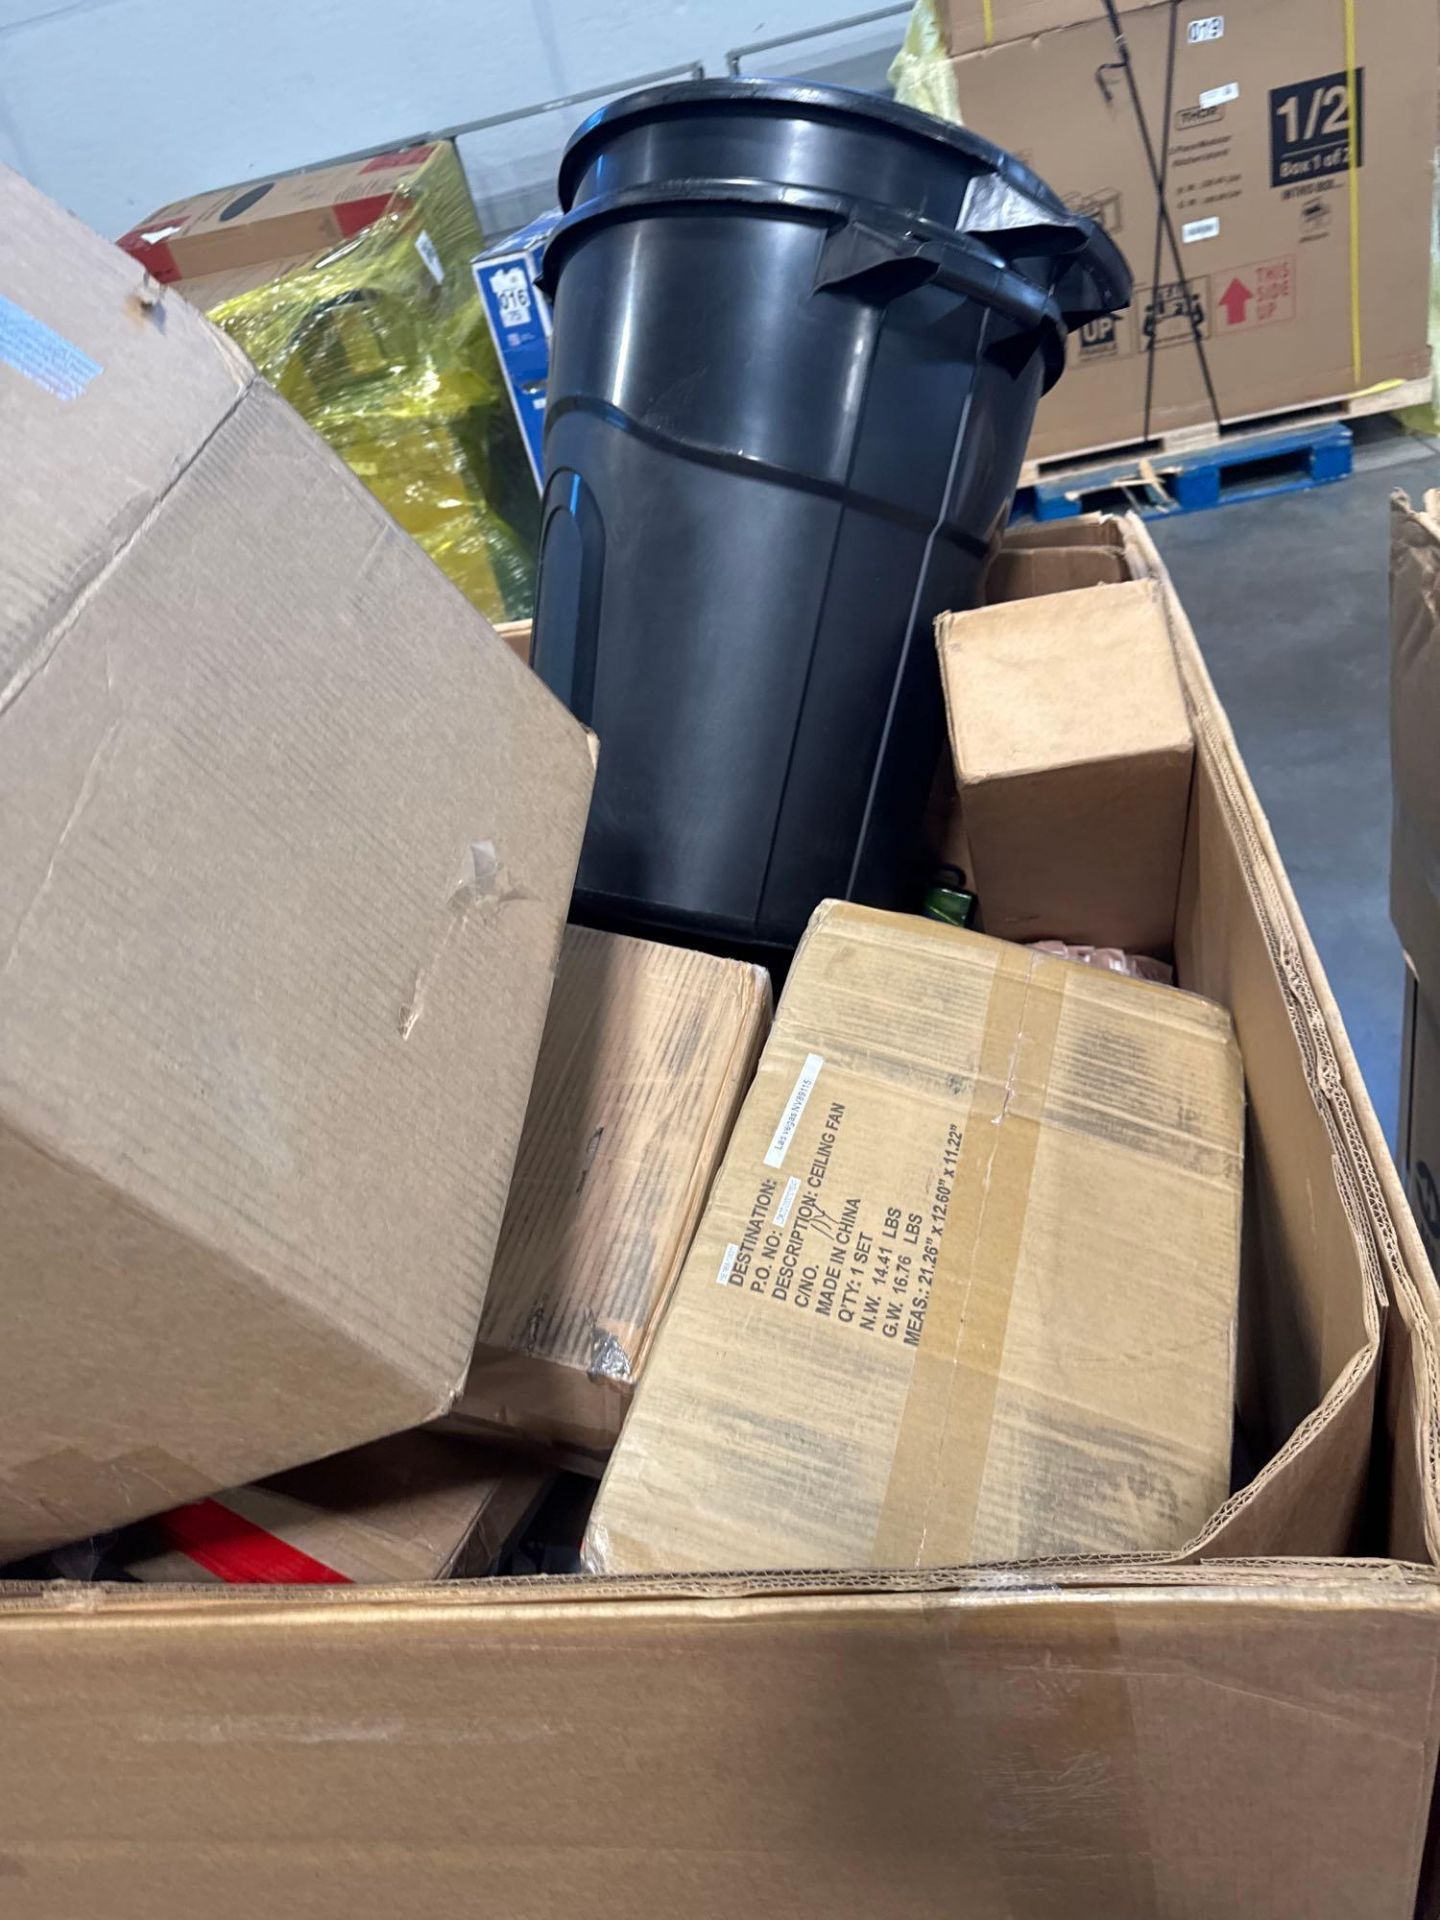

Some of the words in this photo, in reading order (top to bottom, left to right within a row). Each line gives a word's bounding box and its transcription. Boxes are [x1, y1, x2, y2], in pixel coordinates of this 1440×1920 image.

[1276, 84, 1351, 143] 1/2
[1280, 161, 1310, 178] Box
[1313, 154, 1322, 170] 1
[1323, 148, 1343, 167] of
[1256, 261, 1289, 283] THIS
[500, 289, 528, 311] 016
[1256, 280, 1289, 303] SIDE
[1256, 302, 1277, 320] UP
[1083, 317, 1112, 342] UP
[774, 1134, 787, 1150] Las
[771, 1191, 818, 1301] DESCRIPTION:
[807, 1133, 836, 1188] CEILING
[828, 1102, 846, 1132] FAN
[728, 1179, 777, 1287] DESTINATION:
[836, 1198, 861, 1246] CHINA
[750, 1265, 772, 1294] P.O.
[761, 1230, 782, 1260] NO:
[830, 1247, 847, 1264] IN
[855, 1232, 873, 1265] SET
[853, 1267, 864, 1276] 1
[860, 1297, 882, 1332] N.W.
[874, 1247, 892, 1288] 14.41
[883, 1207, 901, 1239] LBS
[883, 1303, 904, 1338] G.W.
[894, 1255, 911, 1297] 16.76
[904, 1213, 922, 1244] LBS
[794, 1265, 819, 1308] C/NO.
[815, 1266, 841, 1316] MADE
